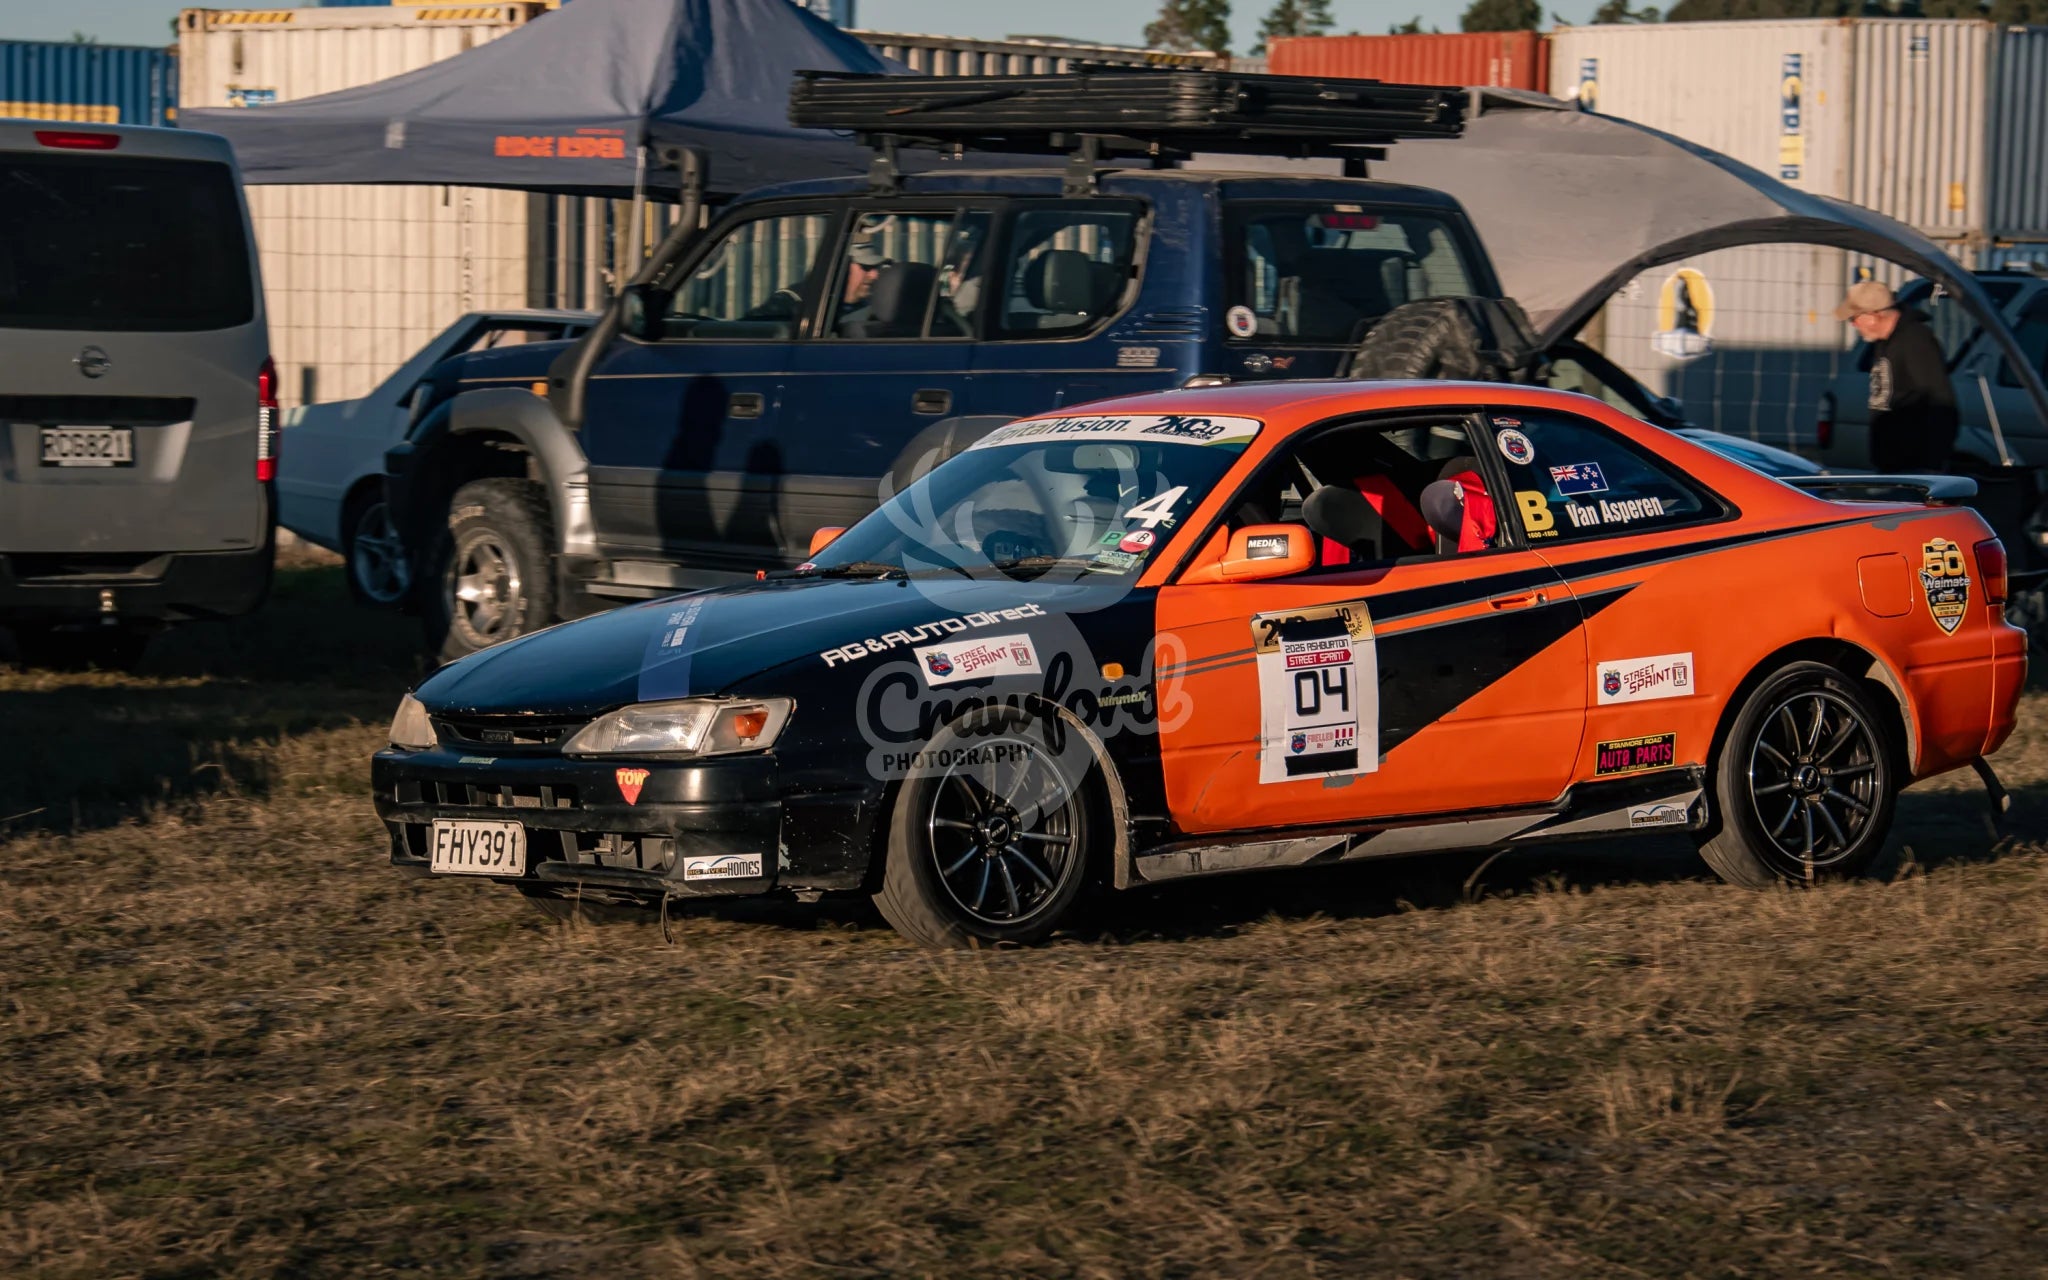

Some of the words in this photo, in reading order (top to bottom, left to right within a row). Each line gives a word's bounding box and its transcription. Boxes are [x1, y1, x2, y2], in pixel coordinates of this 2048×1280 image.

[1123, 485, 1189, 529] 4
[1514, 490, 1554, 532] B
[1565, 503, 1600, 528] Van
[1600, 496, 1665, 524] Asperen
[1103, 532, 1120, 543] P
[1248, 539, 1278, 548] MEDIA
[1924, 551, 1964, 577] 50
[1924, 577, 1970, 588] Waimate
[953, 645, 988, 664] STREET
[1285, 643, 1305, 653] 2026
[1307, 639, 1349, 651] ASHBURTON
[963, 646, 1008, 673] SPRINT
[1289, 654, 1317, 666] STREET
[1319, 650, 1345, 663] SPRINT
[1623, 664, 1655, 684] STREET
[1629, 667, 1671, 695] SPRINT
[1294, 667, 1349, 717] 04
[1334, 738, 1353, 748] KFC
[1609, 739, 1643, 750] STANMORE
[1644, 737, 1662, 745] ROAD
[1636, 743, 1672, 764] PARTS
[619, 771, 646, 786] TOW
[1661, 809, 1686, 824] HOMES
[436, 828, 516, 866] FHY391
[727, 861, 760, 876] HOMES
